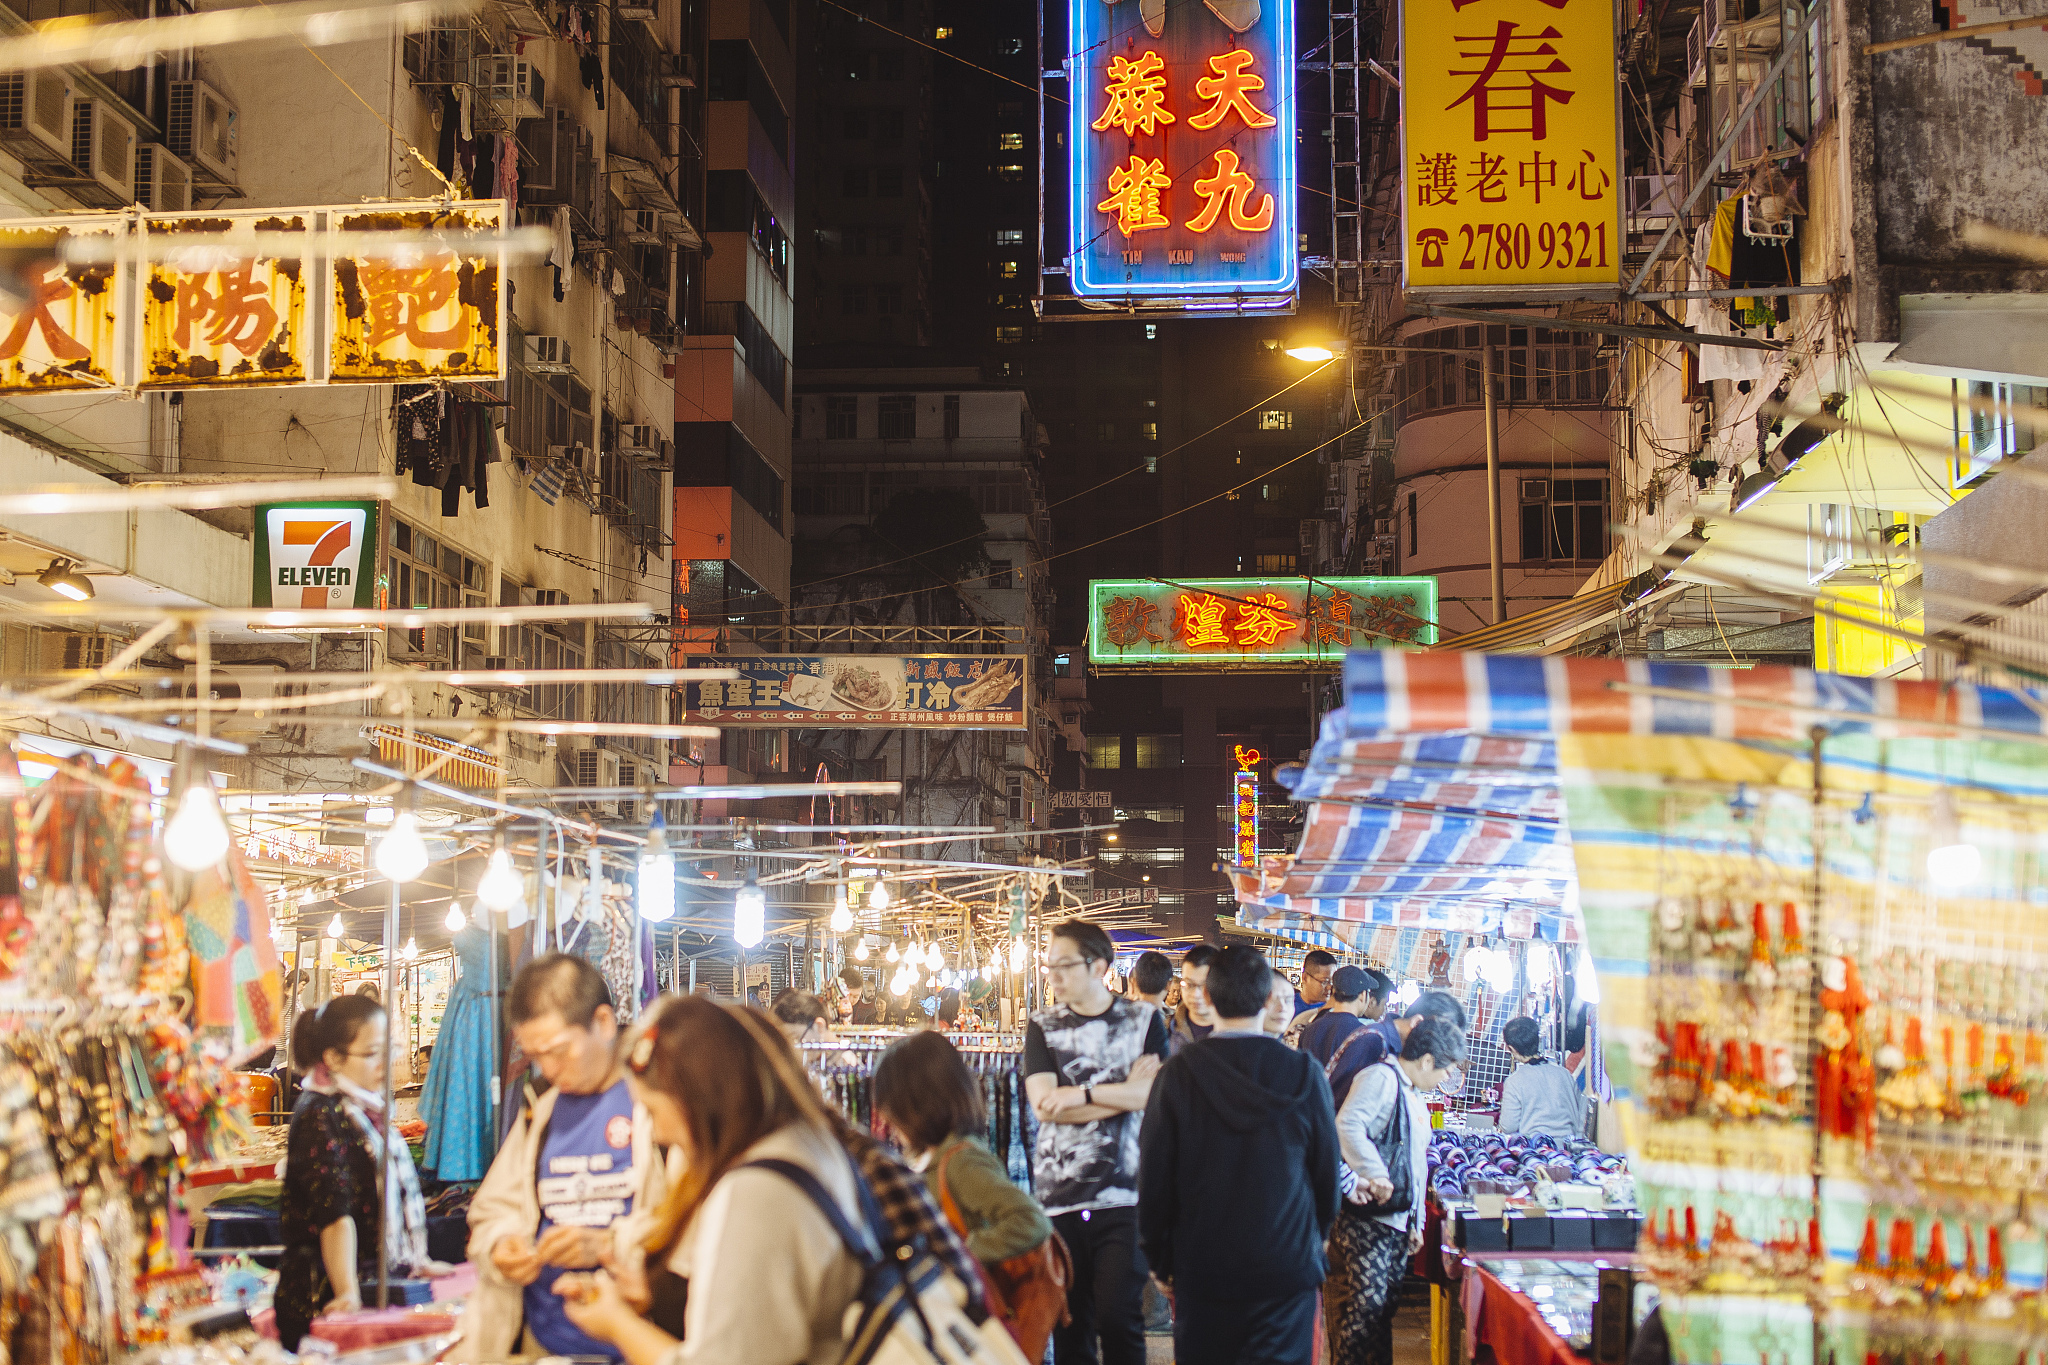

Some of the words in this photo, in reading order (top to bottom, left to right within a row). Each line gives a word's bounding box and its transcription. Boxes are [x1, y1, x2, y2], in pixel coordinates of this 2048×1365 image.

[1445, 0, 1575, 141] 春
[1187, 49, 1277, 233] 天九
[1415, 149, 1610, 207] 護老中心
[1121, 249, 1143, 265] TIN
[1168, 249, 1194, 265] KAU
[1220, 252, 1247, 263] WONG
[1458, 222, 1531, 270] 2780
[1538, 221, 1610, 270] 9321
[698, 678, 781, 707] 魚蛋王
[897, 681, 953, 710] 打冷
[889, 712, 944, 722] 正宗潮州風味
[345, 955, 380, 969] 下午茶
